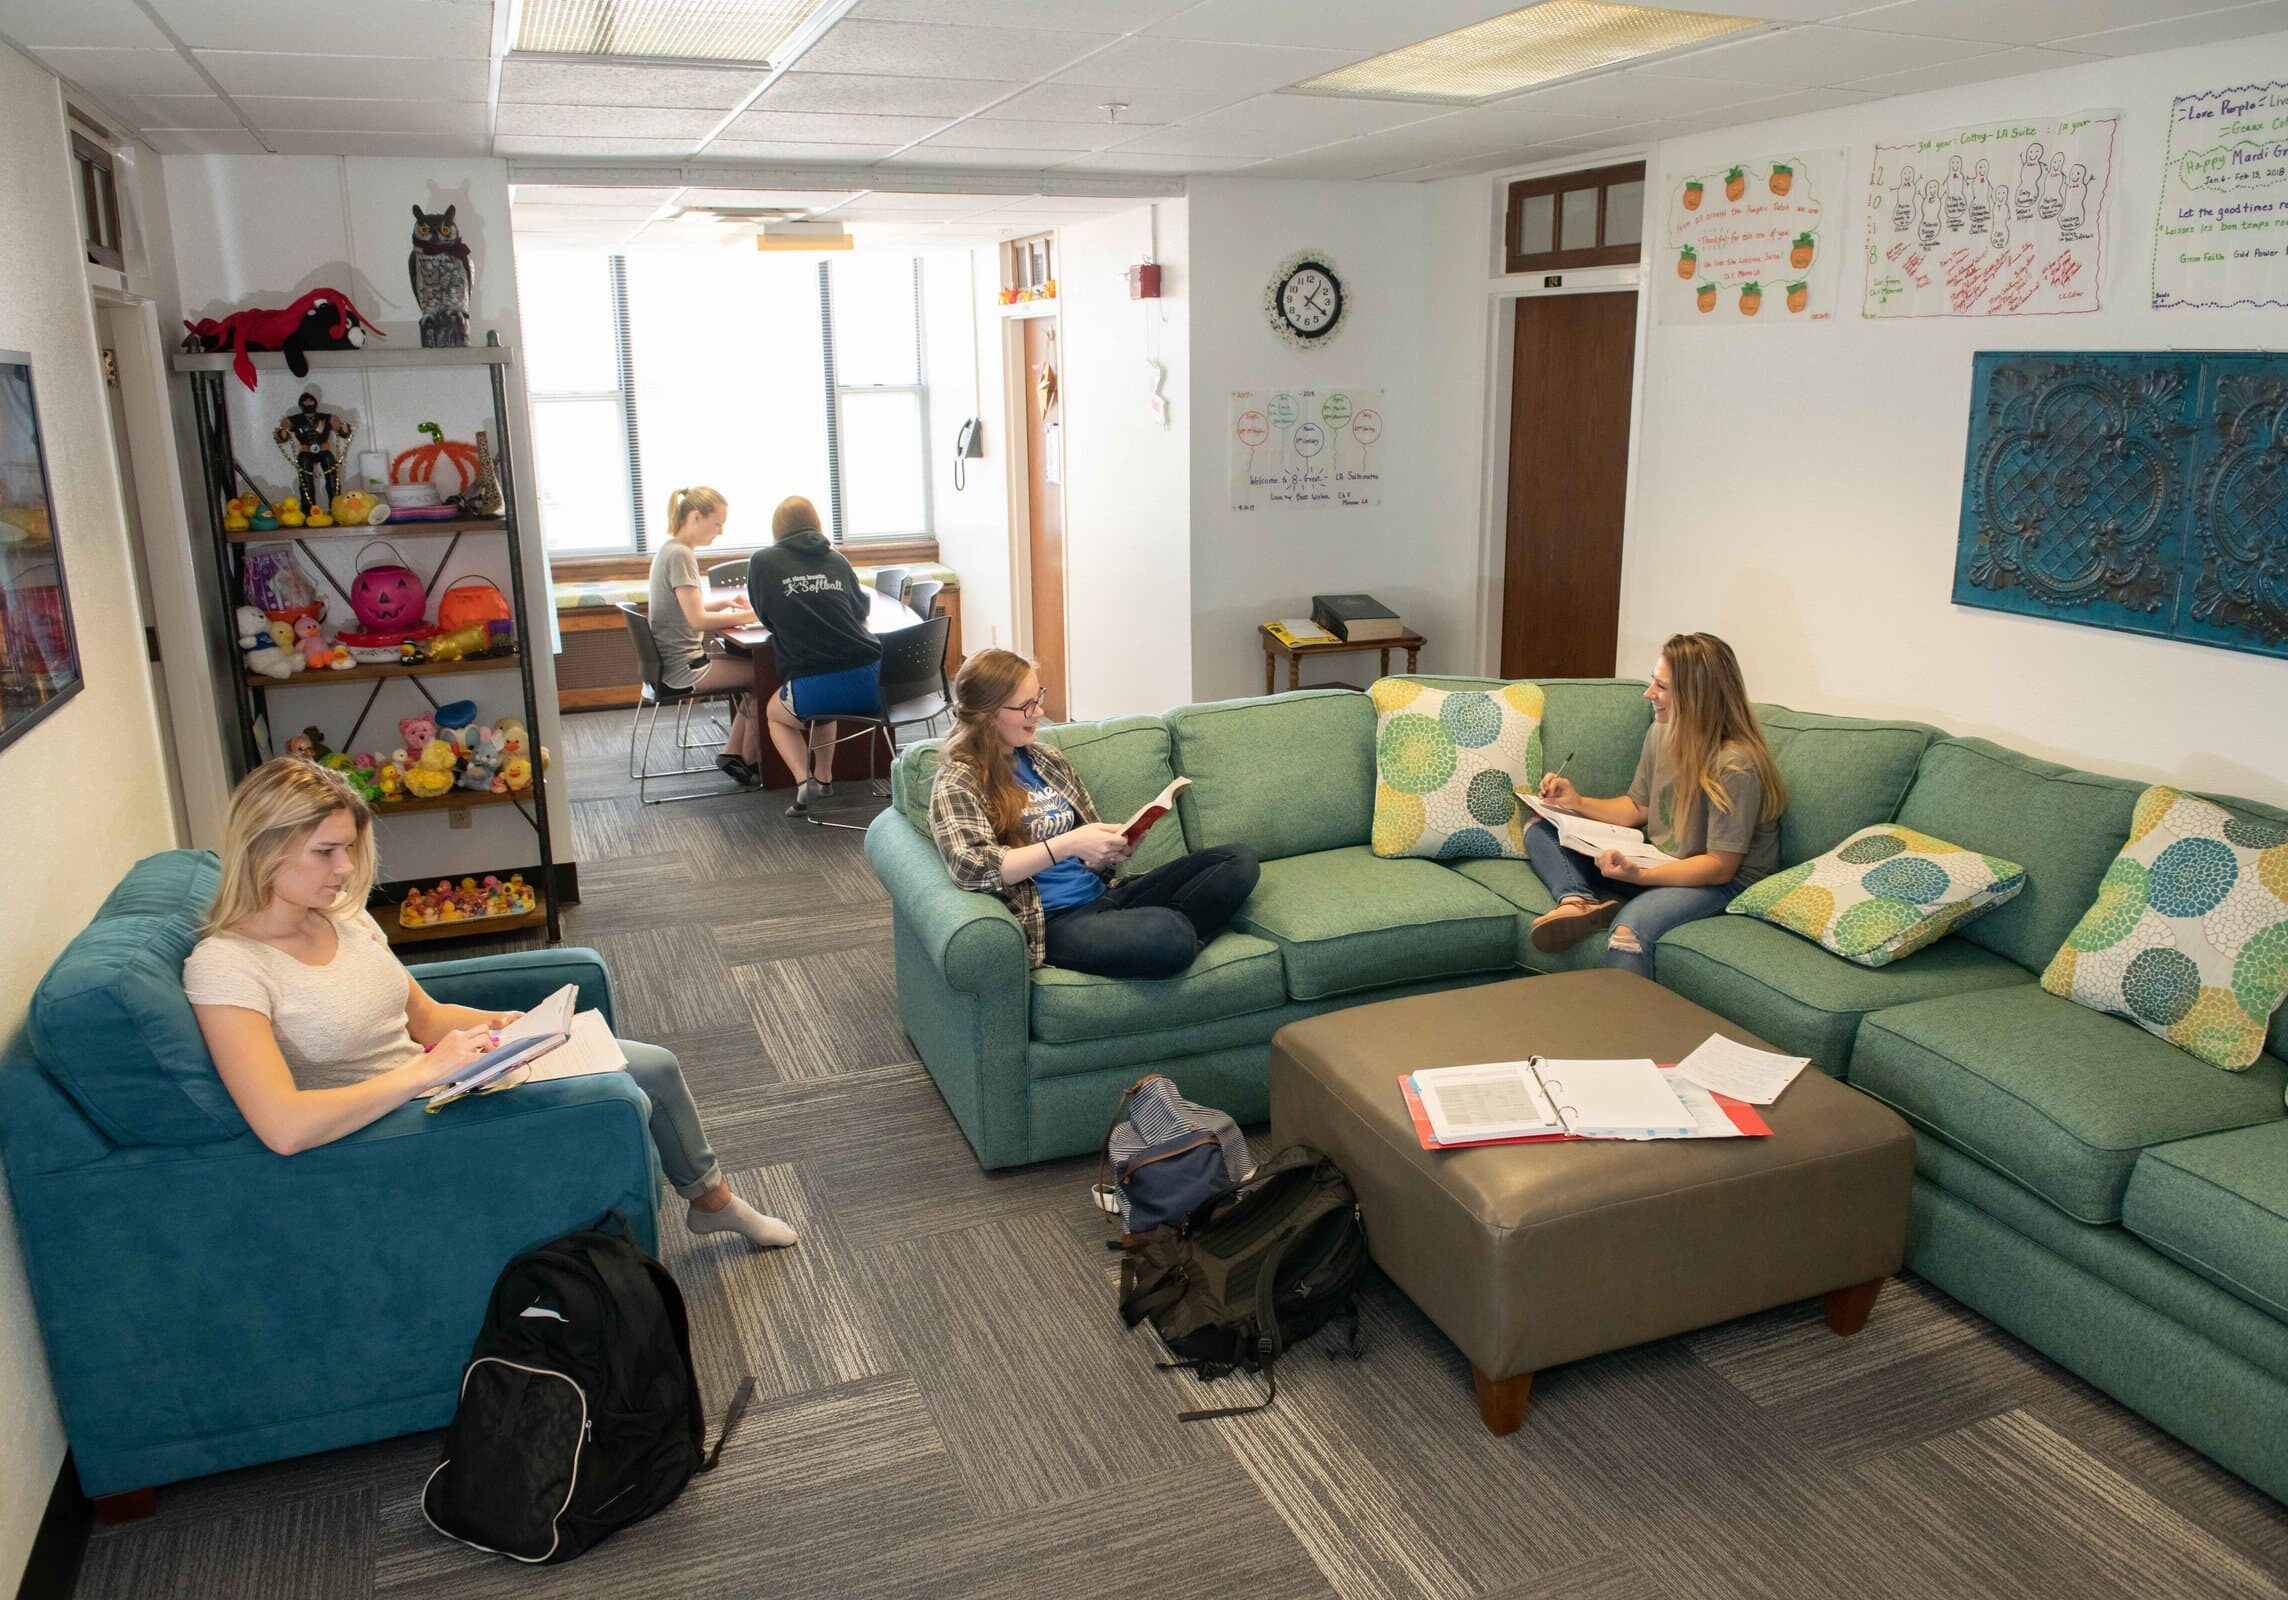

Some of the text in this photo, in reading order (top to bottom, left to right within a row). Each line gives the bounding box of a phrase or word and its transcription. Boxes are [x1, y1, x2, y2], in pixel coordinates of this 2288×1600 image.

[2188, 105, 2215, 120] Love
[2221, 99, 2256, 117] Purple
[2186, 154, 2225, 174] Happy
[2232, 146, 2269, 166] Mardi
[2266, 167, 2286, 177] 2018
[2178, 207, 2194, 218] Let
[2198, 206, 2214, 218] the
[2216, 204, 2241, 222] good
[2244, 202, 2273, 214] times
[1306, 275, 1315, 284] 12
[1287, 295, 1292, 303] 9
[1324, 298, 1330, 306] 3
[1289, 306, 1295, 314] 8
[1304, 318, 1310, 326] 6
[1313, 315, 1319, 323] 5
[800, 579, 844, 593] Softball
